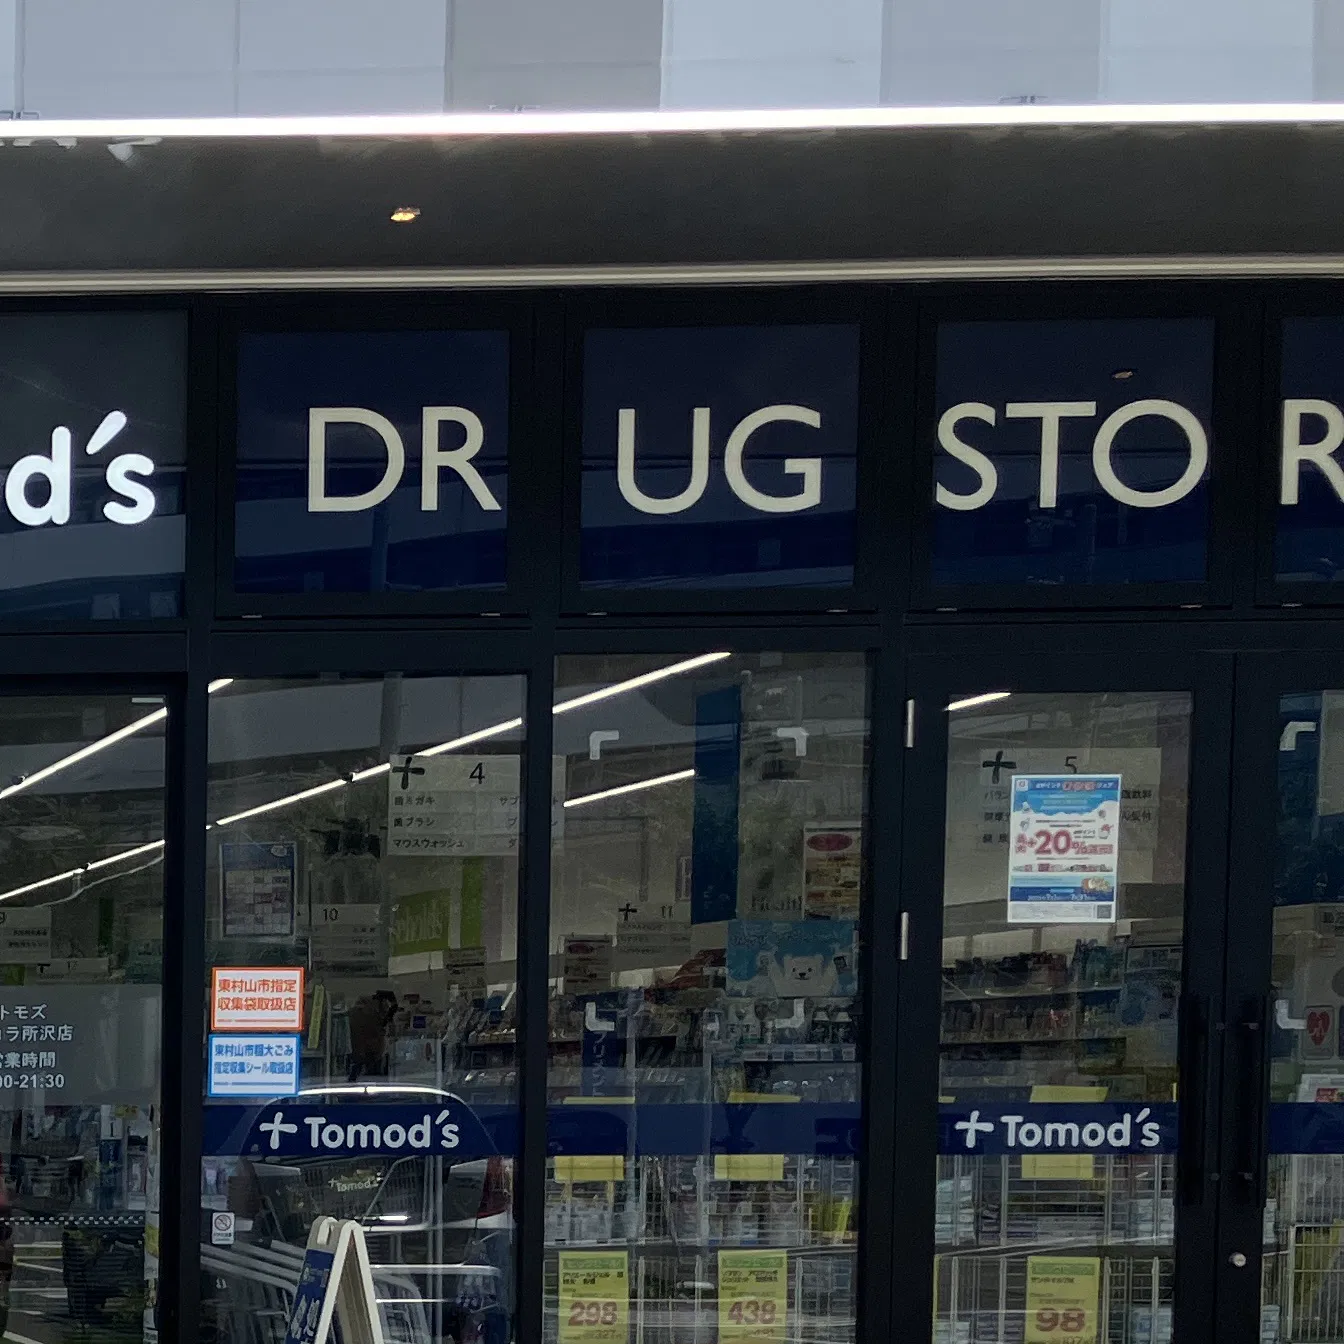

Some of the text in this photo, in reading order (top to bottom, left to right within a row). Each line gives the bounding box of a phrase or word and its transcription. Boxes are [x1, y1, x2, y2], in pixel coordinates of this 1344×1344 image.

[469, 762, 486, 785] 4
[322, 908, 340, 921] 10
[217, 978, 297, 993] 東村山市指定
[0, 1003, 48, 1021] トモズ
[217, 997, 297, 1011] 収集袋取扱店
[303, 1109, 460, 1149] Tomod's
[999, 1107, 1161, 1147] Tomod's
